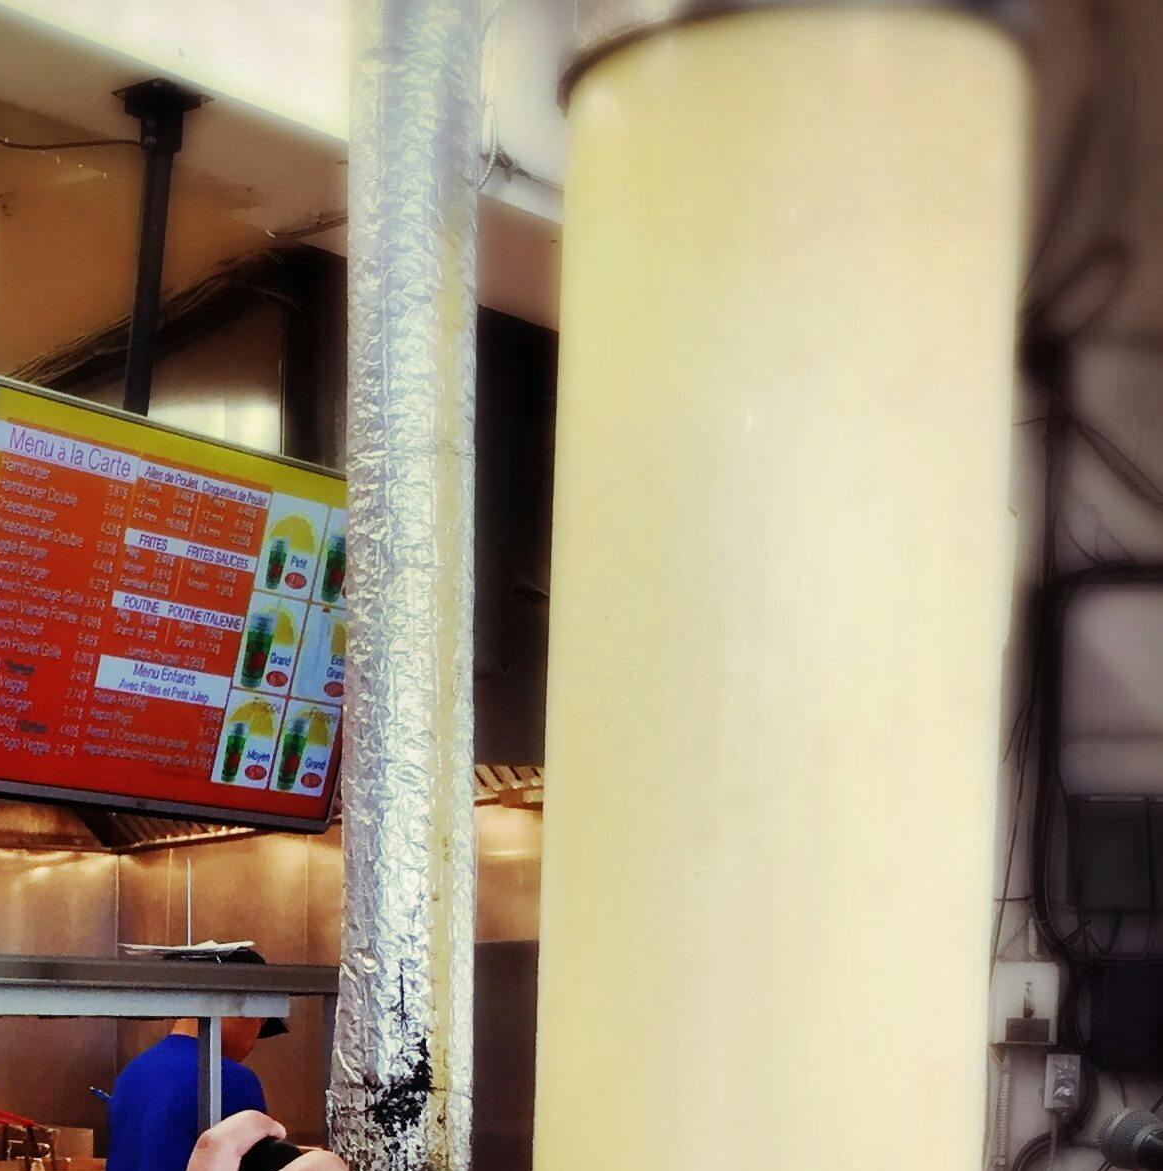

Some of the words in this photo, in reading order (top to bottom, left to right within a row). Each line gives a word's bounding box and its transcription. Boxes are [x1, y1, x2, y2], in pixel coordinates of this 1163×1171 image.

[9, 427, 55, 460] Menu
[57, 441, 68, 461] à
[70, 443, 85, 466] la
[88, 448, 131, 478] Carte
[139, 535, 168, 550] FRITES
[187, 546, 215, 561] FRITES
[22, 582, 62, 604] Fromage
[124, 596, 160, 613] POUTINE
[168, 605, 202, 621] POUTINE
[204, 612, 241, 629] ITALIENNE
[269, 652, 292, 667] Grand
[133, 663, 160, 680] Menu
[161, 668, 196, 686] Enfants
[119, 678, 139, 691] Avec
[140, 682, 160, 694] Frites
[304, 756, 327, 772] Grand
